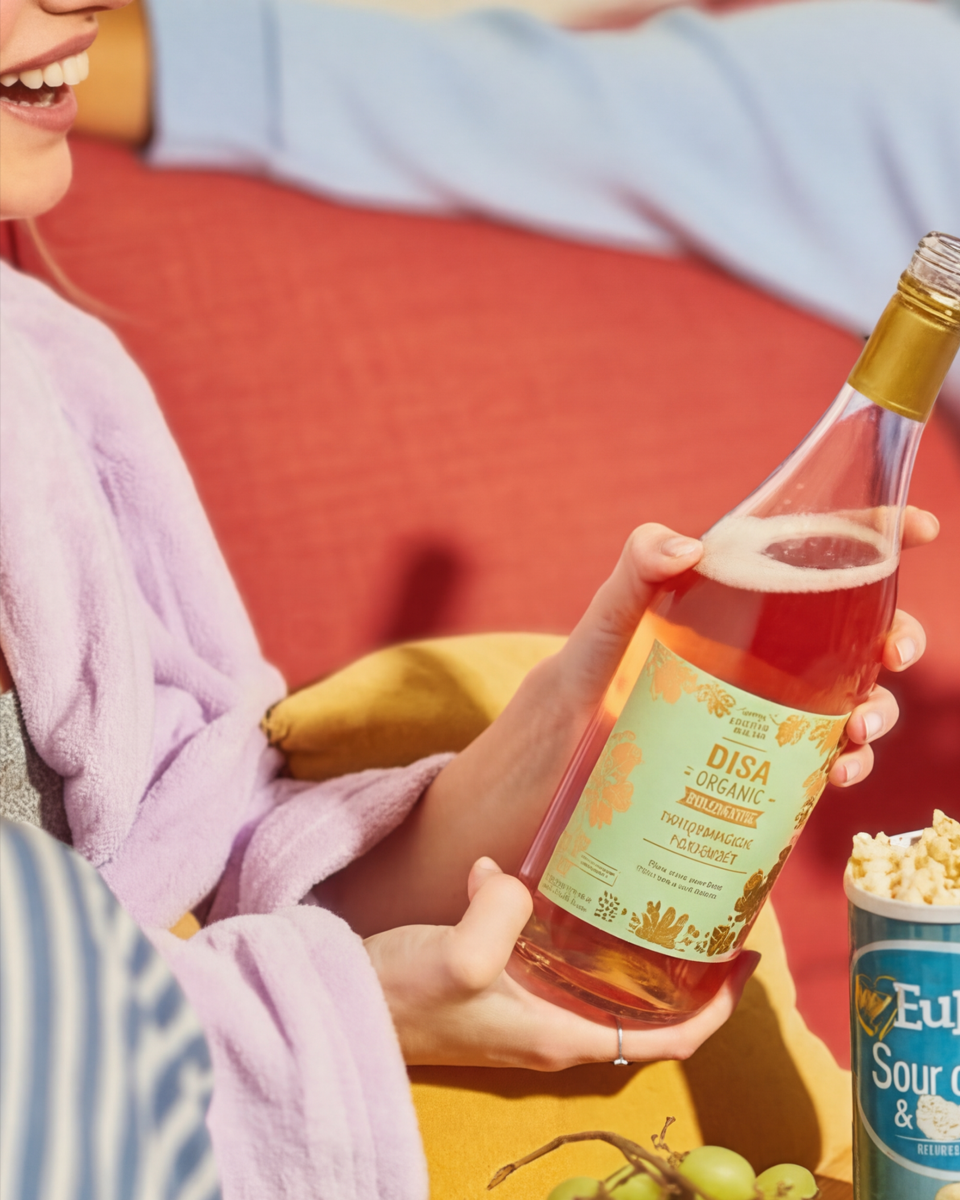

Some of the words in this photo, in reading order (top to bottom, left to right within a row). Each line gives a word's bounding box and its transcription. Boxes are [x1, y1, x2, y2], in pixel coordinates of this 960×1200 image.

[706, 743, 771, 786] DISA
[696, 770, 765, 805] ORGANIC
[872, 1042, 943, 1096] Sour
[894, 1099, 913, 1129] &
